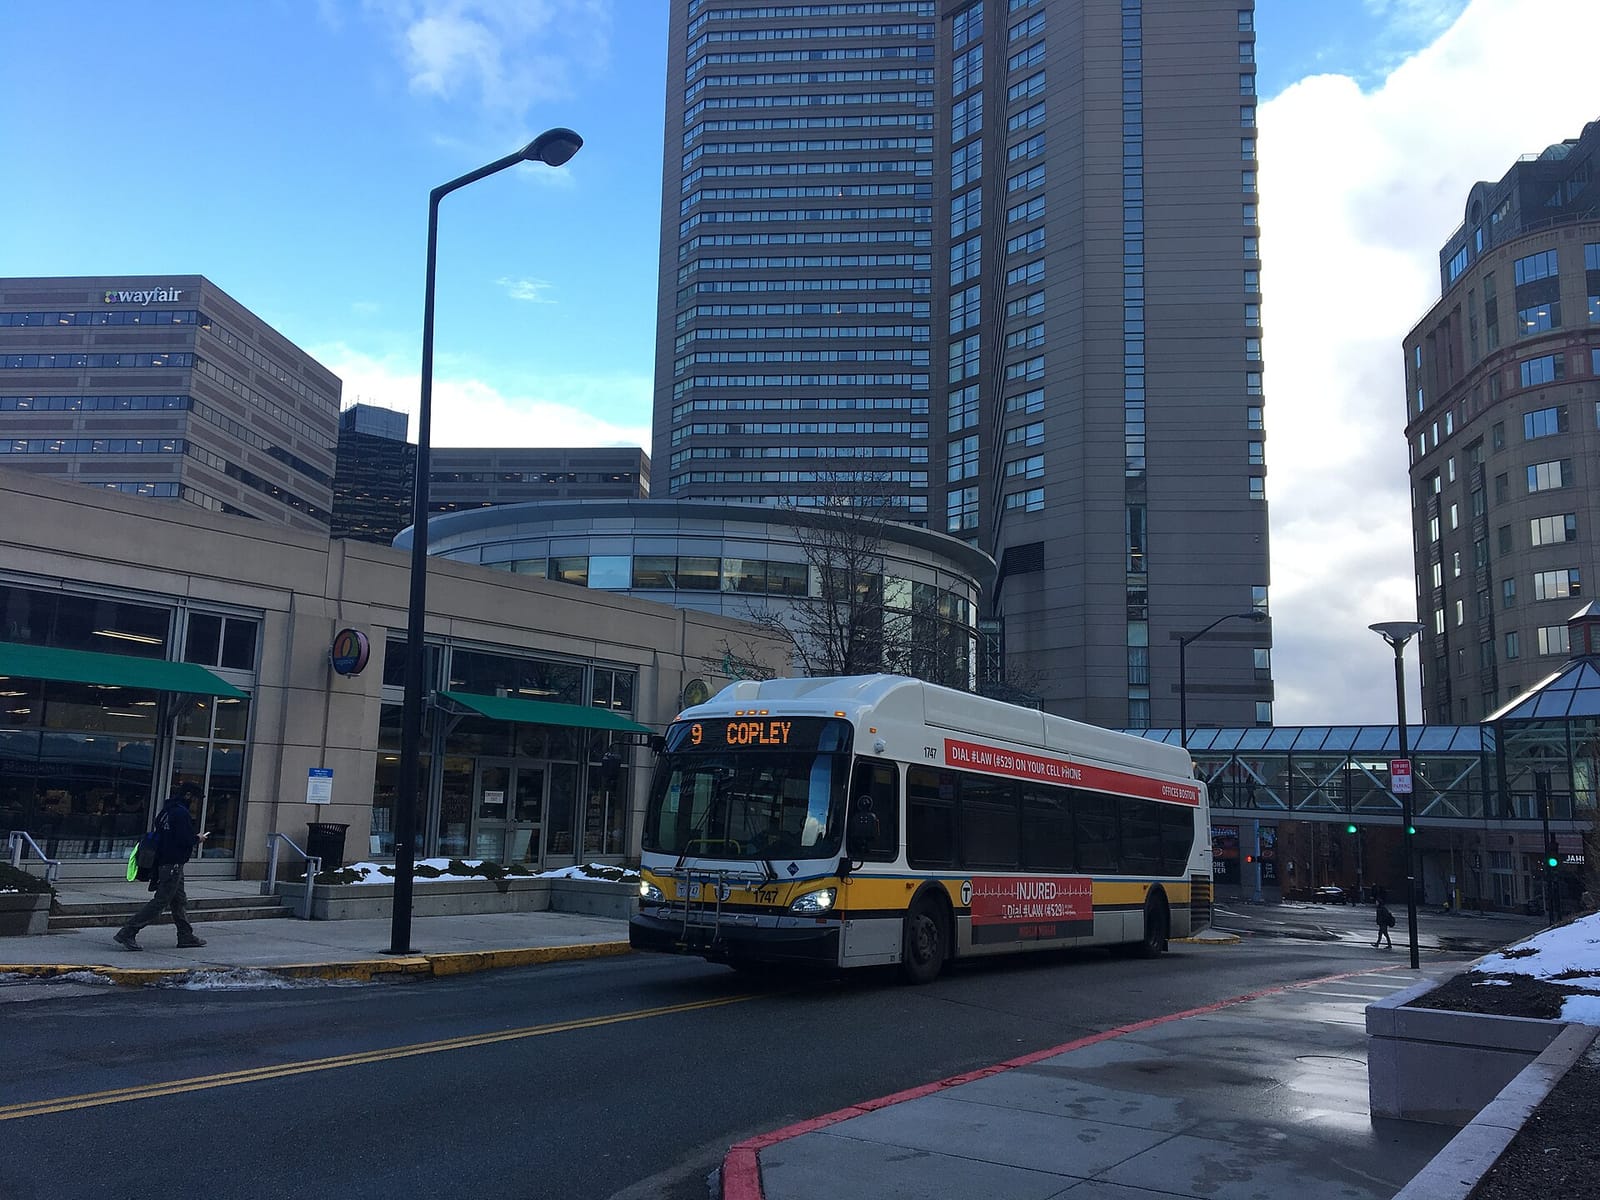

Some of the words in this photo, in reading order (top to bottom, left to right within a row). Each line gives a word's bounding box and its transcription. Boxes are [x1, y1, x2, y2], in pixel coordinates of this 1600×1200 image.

[118, 286, 182, 306] wayfair
[691, 723, 703, 744] 9
[727, 722, 791, 744] COPLEY
[923, 746, 937, 760] 1747
[952, 746, 970, 762] DIAL
[971, 750, 993, 766] #LAW
[993, 753, 1015, 770] (#529)
[1015, 758, 1026, 771] ON
[1027, 760, 1046, 775] YOUR
[1046, 764, 1061, 777] CELL
[1061, 766, 1082, 781] PHONE
[1161, 785, 1179, 798] OFFICES
[1179, 789, 1196, 801] BOSTON
[753, 890, 779, 904] 1747
[1016, 881, 1057, 901] INJURED
[1007, 904, 1023, 919] Dial
[1023, 904, 1044, 918] #LAW
[1044, 903, 1065, 917] (#529)
